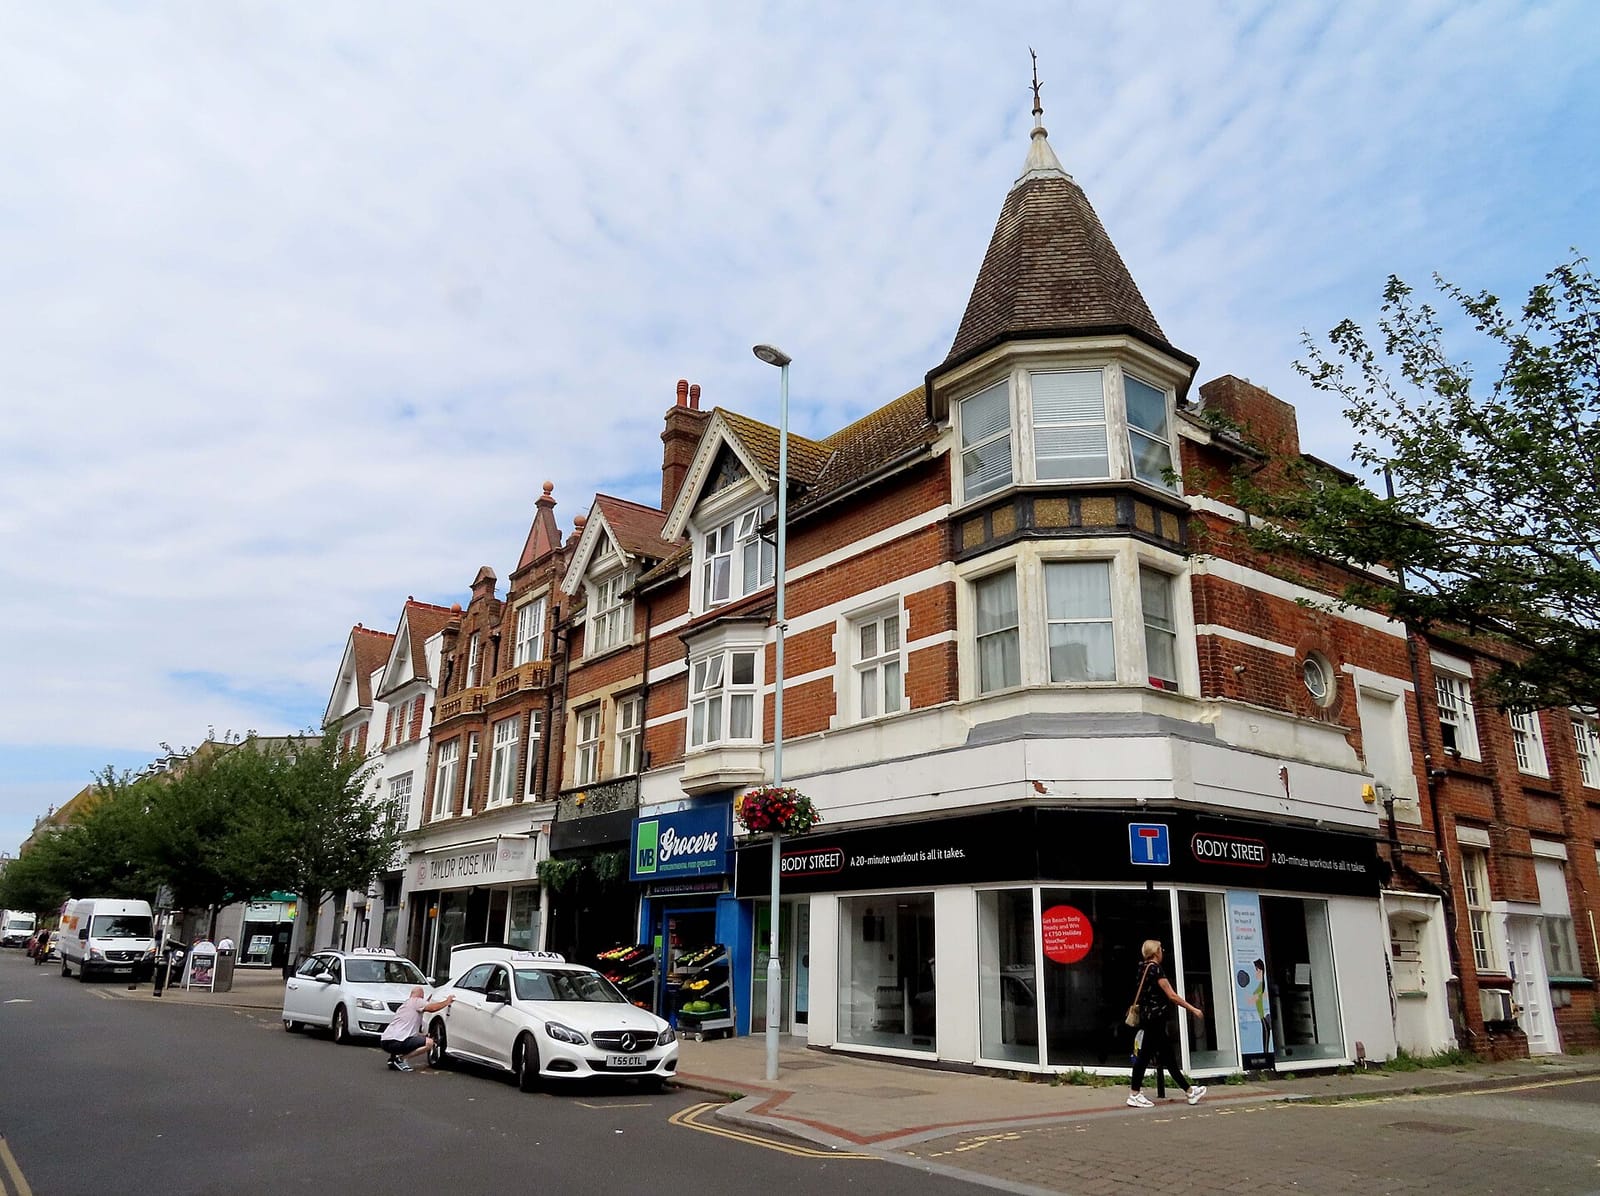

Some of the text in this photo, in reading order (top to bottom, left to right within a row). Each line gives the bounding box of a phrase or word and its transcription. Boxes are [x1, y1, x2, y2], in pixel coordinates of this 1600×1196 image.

[660, 827, 718, 862] Grocers
[1196, 839, 1264, 862] BODY STREET
[639, 848, 654, 867] MB
[781, 852, 840, 871] BODY STREET
[850, 847, 966, 867] A 20-minute workout is all it takes.
[1271, 852, 1278, 863] A
[1277, 852, 1309, 867] 20-minute
[1309, 858, 1332, 869] workout
[1332, 859, 1338, 870] is
[1338, 860, 1346, 870] all
[430, 857, 456, 880] TAYLOR
[457, 854, 479, 877] ROSE
[366, 946, 386, 954] TAXI
[528, 951, 559, 959] TAXI
[628, 1056, 642, 1066] CTL
